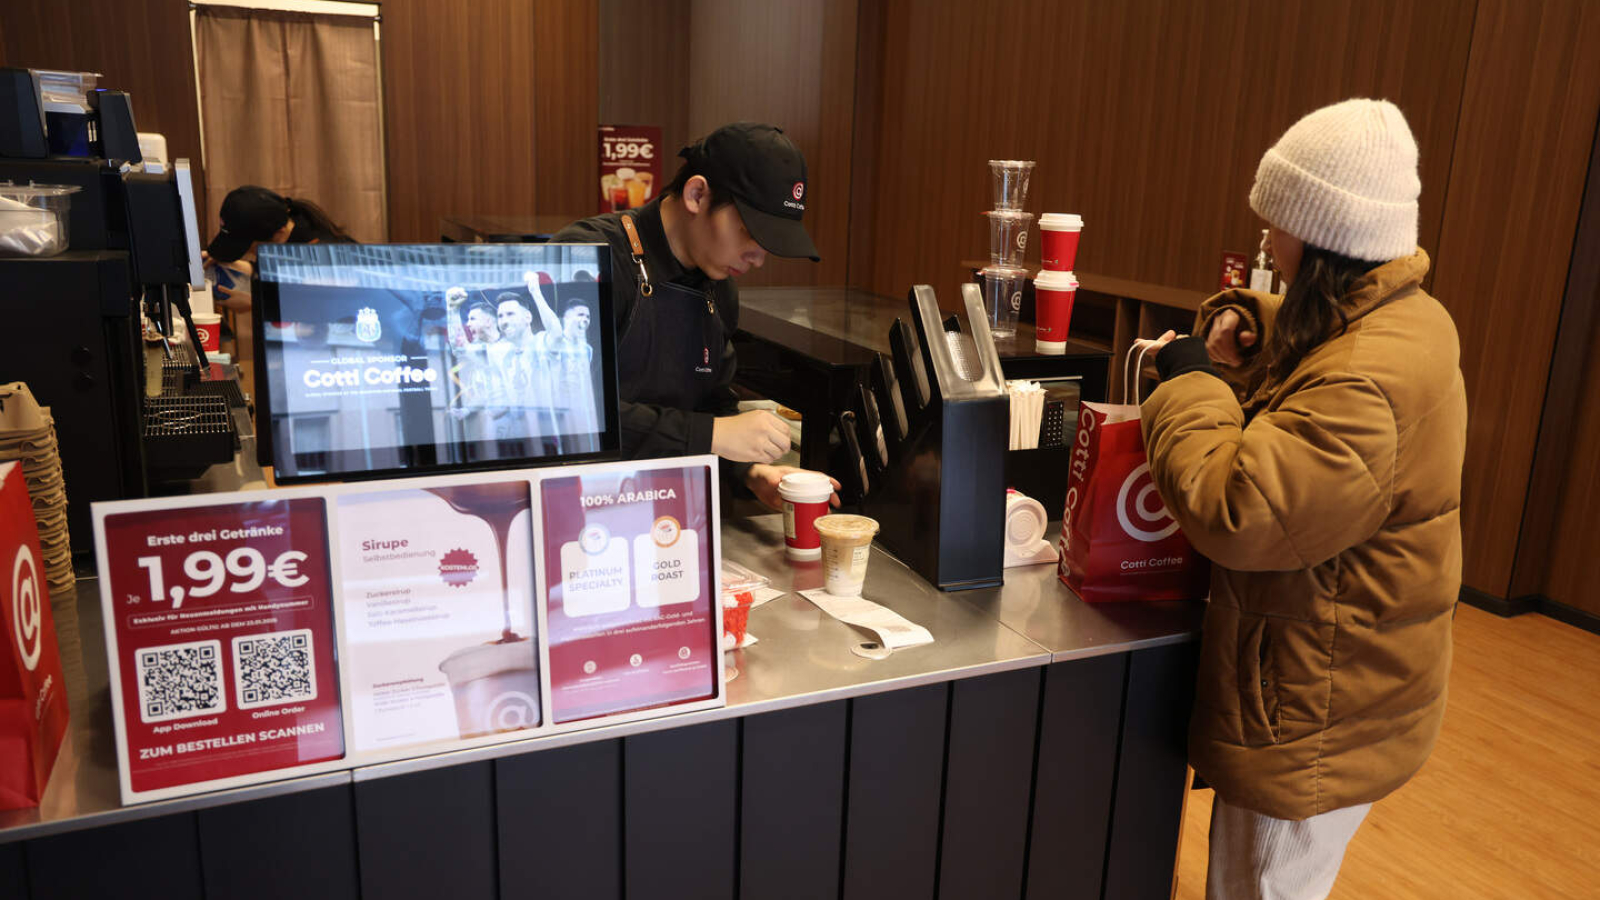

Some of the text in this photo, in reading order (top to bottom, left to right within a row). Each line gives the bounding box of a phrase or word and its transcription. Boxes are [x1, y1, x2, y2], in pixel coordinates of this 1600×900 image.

[603, 142, 654, 160] 1,99€
[303, 366, 437, 388] Cotti Coffee
[1072, 408, 1096, 482] Cotti
[580, 488, 676, 507] 100% ARABICA
[147, 525, 284, 546] Erste drei Getränke
[362, 539, 409, 551] Sirupe
[652, 559, 681, 571] GOLD
[1120, 556, 1183, 570] Cotti Coffee
[126, 547, 310, 609] Je 1,99€
[569, 566, 623, 580] PLATINUM
[651, 570, 684, 581] ROAST
[569, 578, 623, 592] SPECIALTY
[252, 705, 306, 719] Online Order
[153, 717, 218, 734] App Download
[140, 745, 173, 760] ZUM
[176, 732, 255, 754] BESTELLEN
[259, 721, 325, 742] SCANNEN
